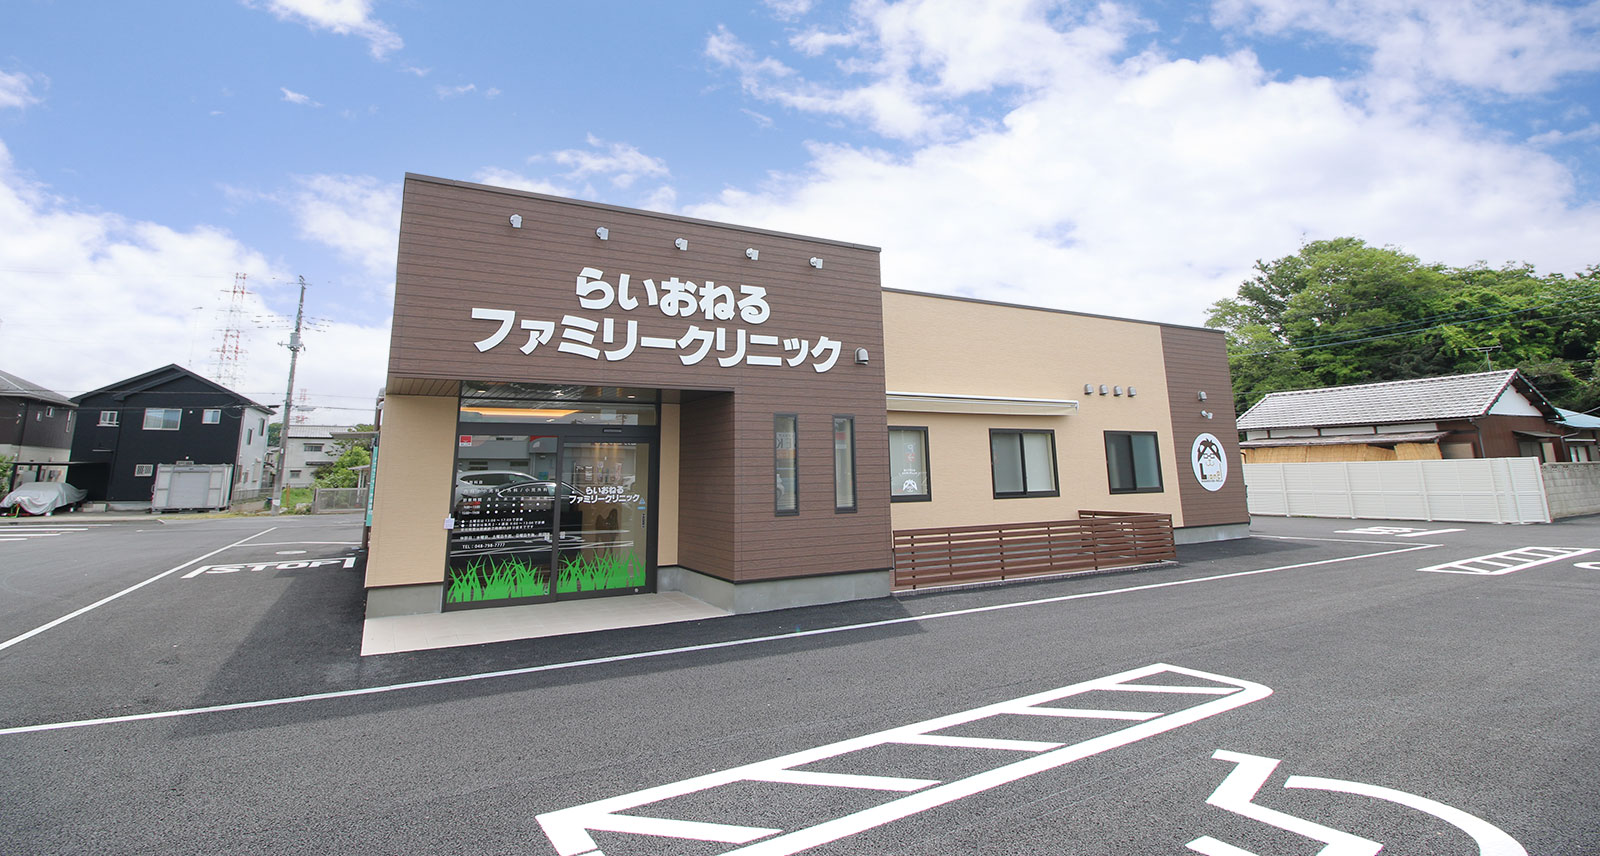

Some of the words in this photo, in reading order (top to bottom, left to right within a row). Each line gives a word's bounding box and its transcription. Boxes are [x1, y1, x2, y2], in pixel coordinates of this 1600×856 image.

[575, 267, 771, 324] らいおねる
[471, 307, 842, 374] ファミリークリニック
[586, 486, 624, 495] らいおねる
[568, 494, 640, 504] ファミリークリニック
[206, 559, 342, 574] STOP
